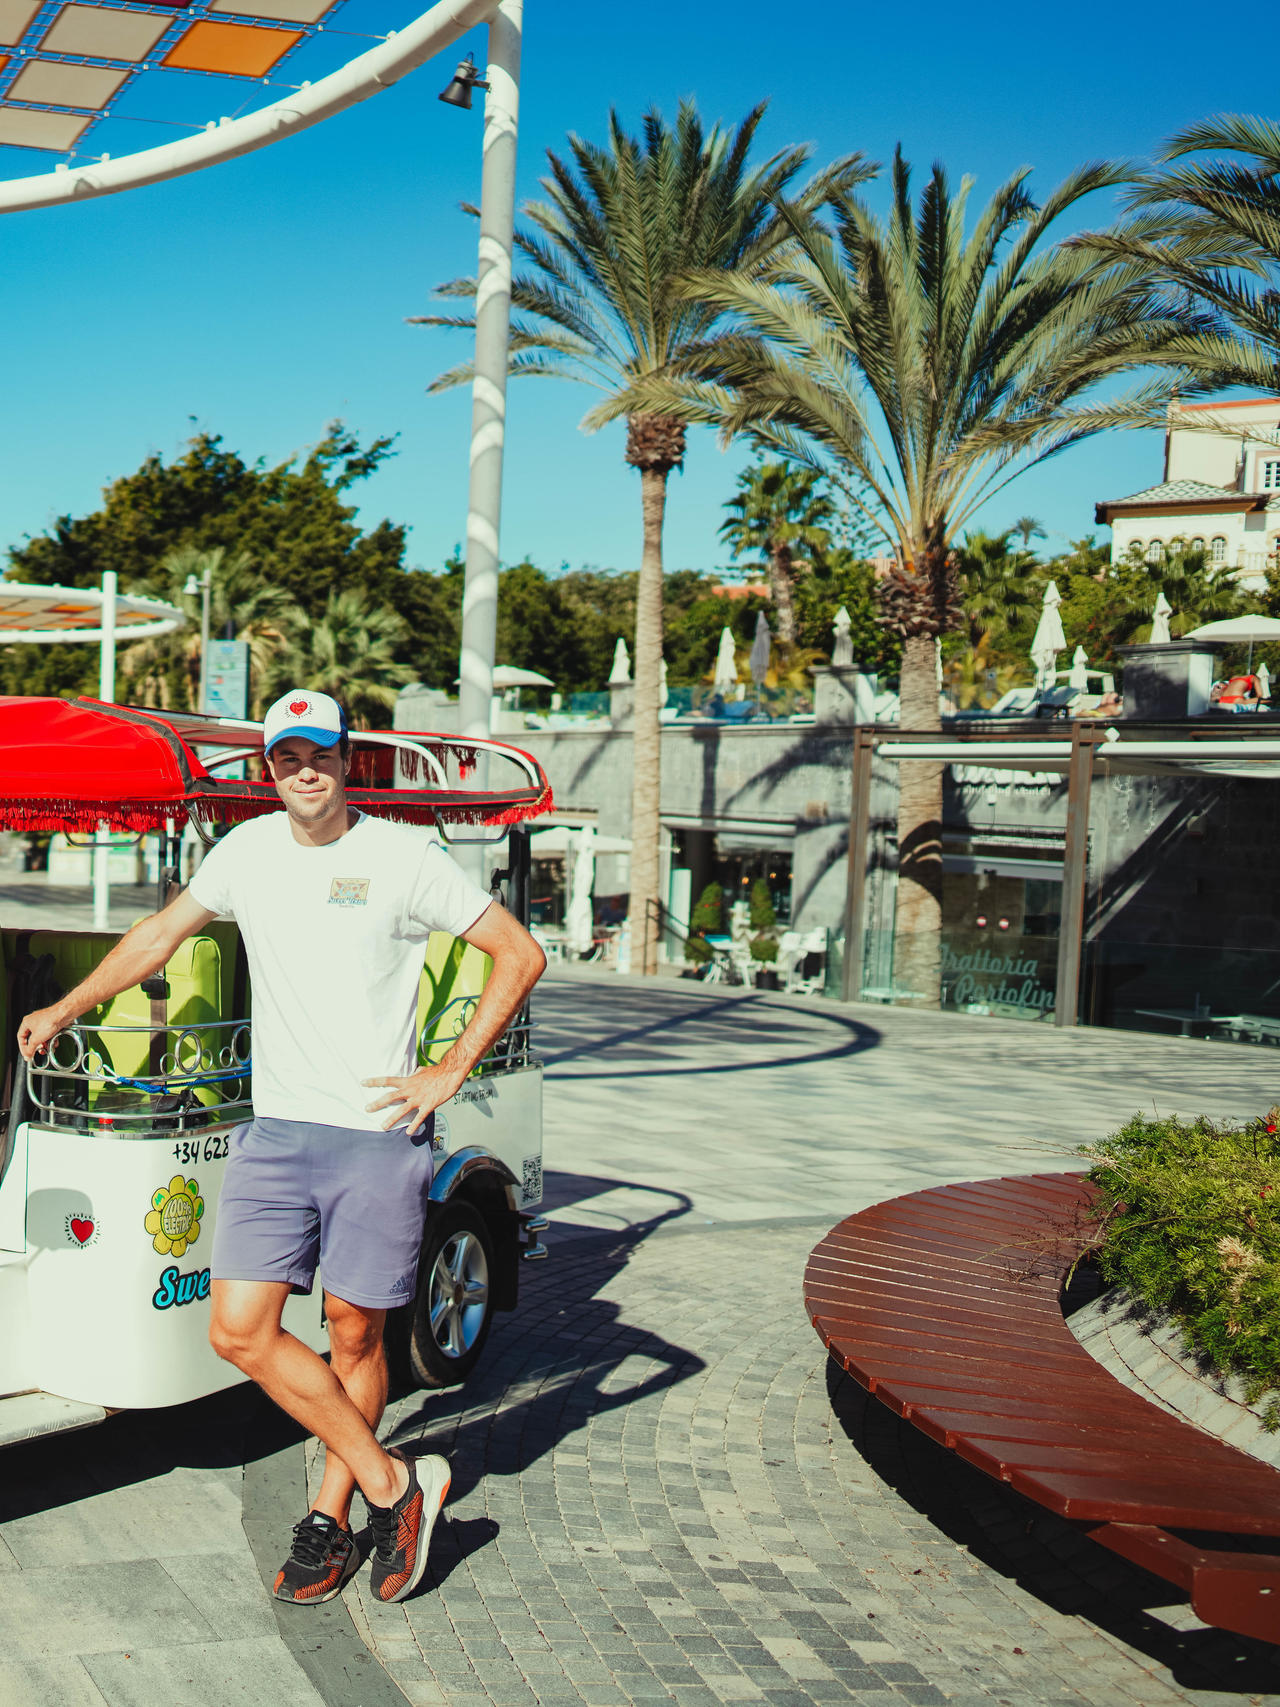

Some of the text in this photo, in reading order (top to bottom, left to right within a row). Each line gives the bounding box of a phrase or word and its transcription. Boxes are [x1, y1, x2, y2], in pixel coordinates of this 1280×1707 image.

[172, 1140, 200, 1165] +34
[164, 1198, 192, 1219] 100%
[164, 1214, 192, 1235] ELECTRIC
